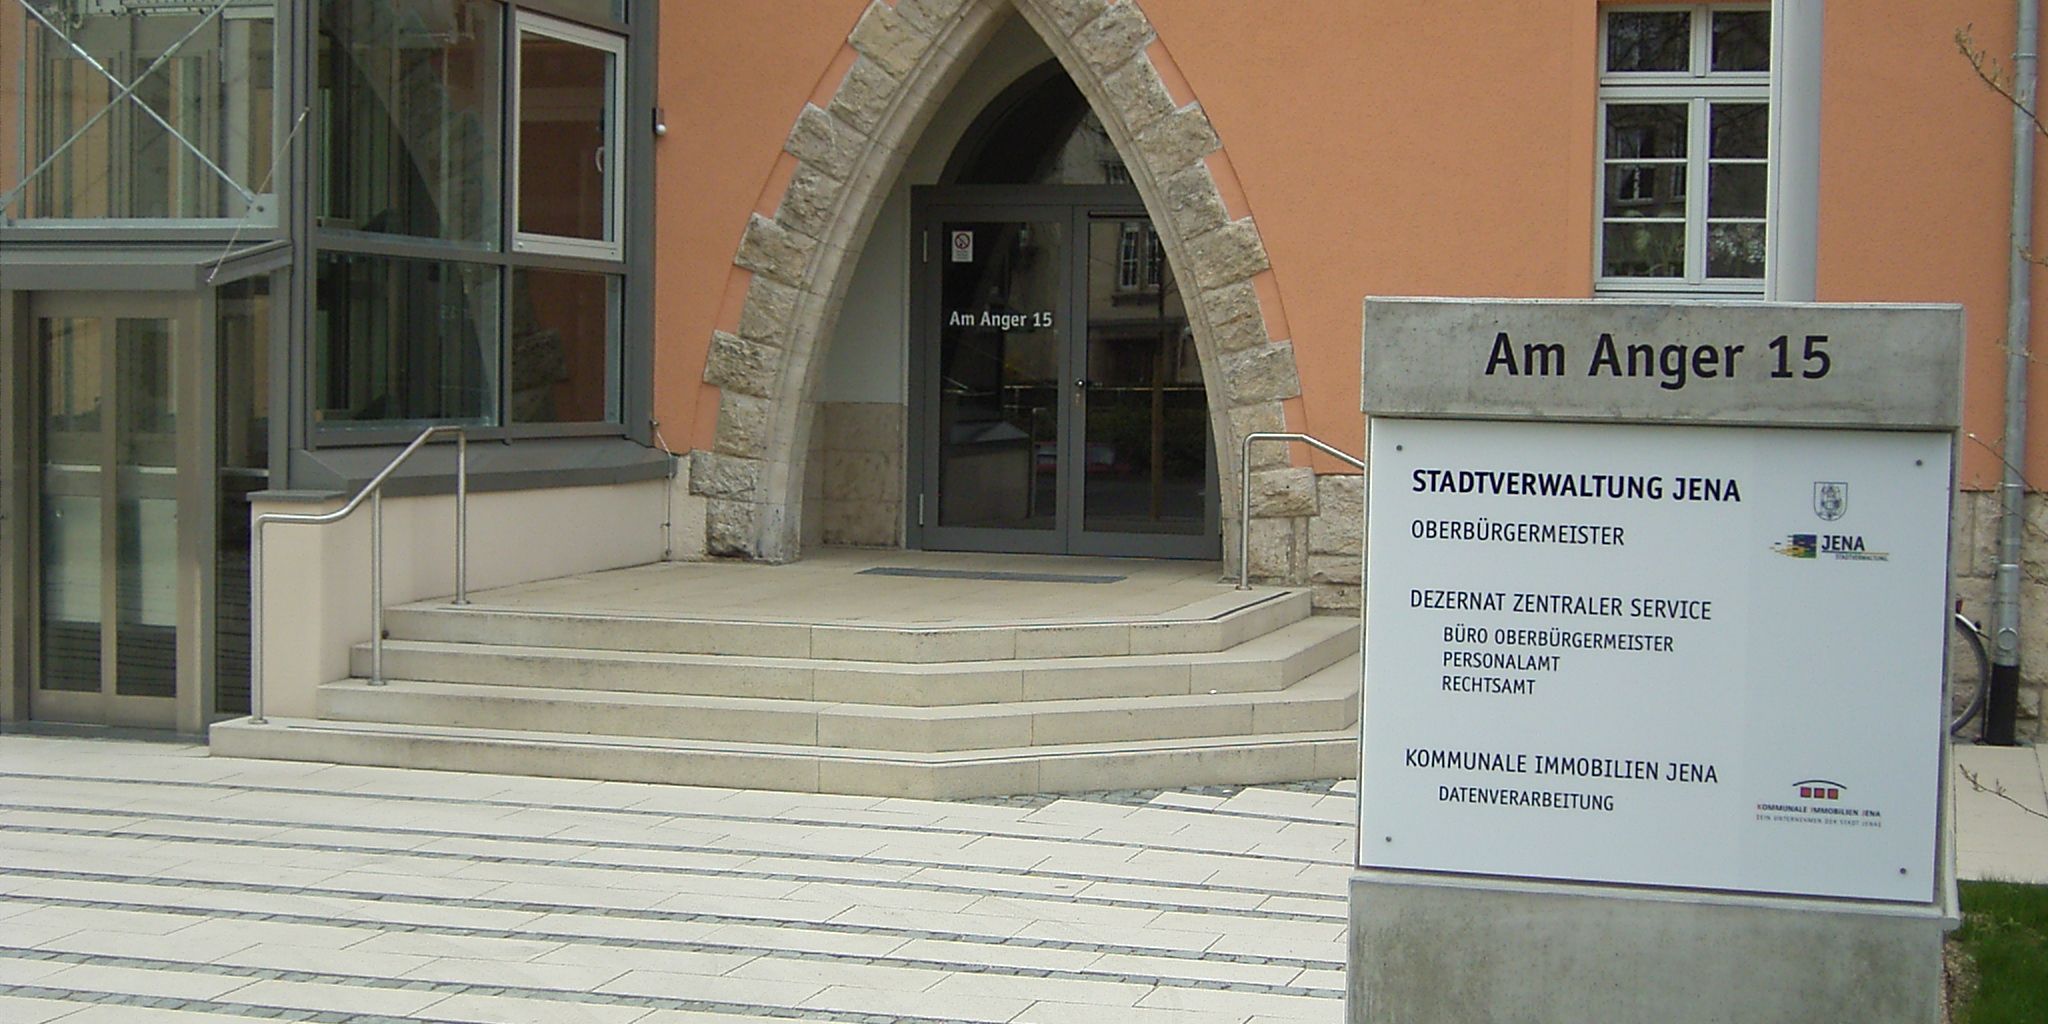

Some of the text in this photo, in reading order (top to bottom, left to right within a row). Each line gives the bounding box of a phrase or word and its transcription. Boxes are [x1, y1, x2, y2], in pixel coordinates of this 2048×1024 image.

[949, 310, 1053, 331] Am Anger 15
[1484, 332, 1831, 390] Am Anger 15
[1412, 469, 1741, 503] STADTVERWALTUNG JENA
[1411, 518, 1625, 546] OBERBÜRGERMEISTER
[1821, 535, 1865, 551] JENA
[1411, 589, 1712, 621] DEZERNAT ZENTRALER SERVICE
[1443, 623, 1674, 653] BÜRO OBERBÜRGERMEISTER
[1443, 651, 1561, 672] PERSONALAMT
[1442, 675, 1536, 695] RECHTSAMT
[1406, 748, 1718, 784] KOMMUNALE IMMOBILIEN JENA
[1439, 785, 1614, 812] DATENVERARBEITUNG
[1757, 804, 1881, 817] KOMMUNALE IMMOBILIEN JENA
